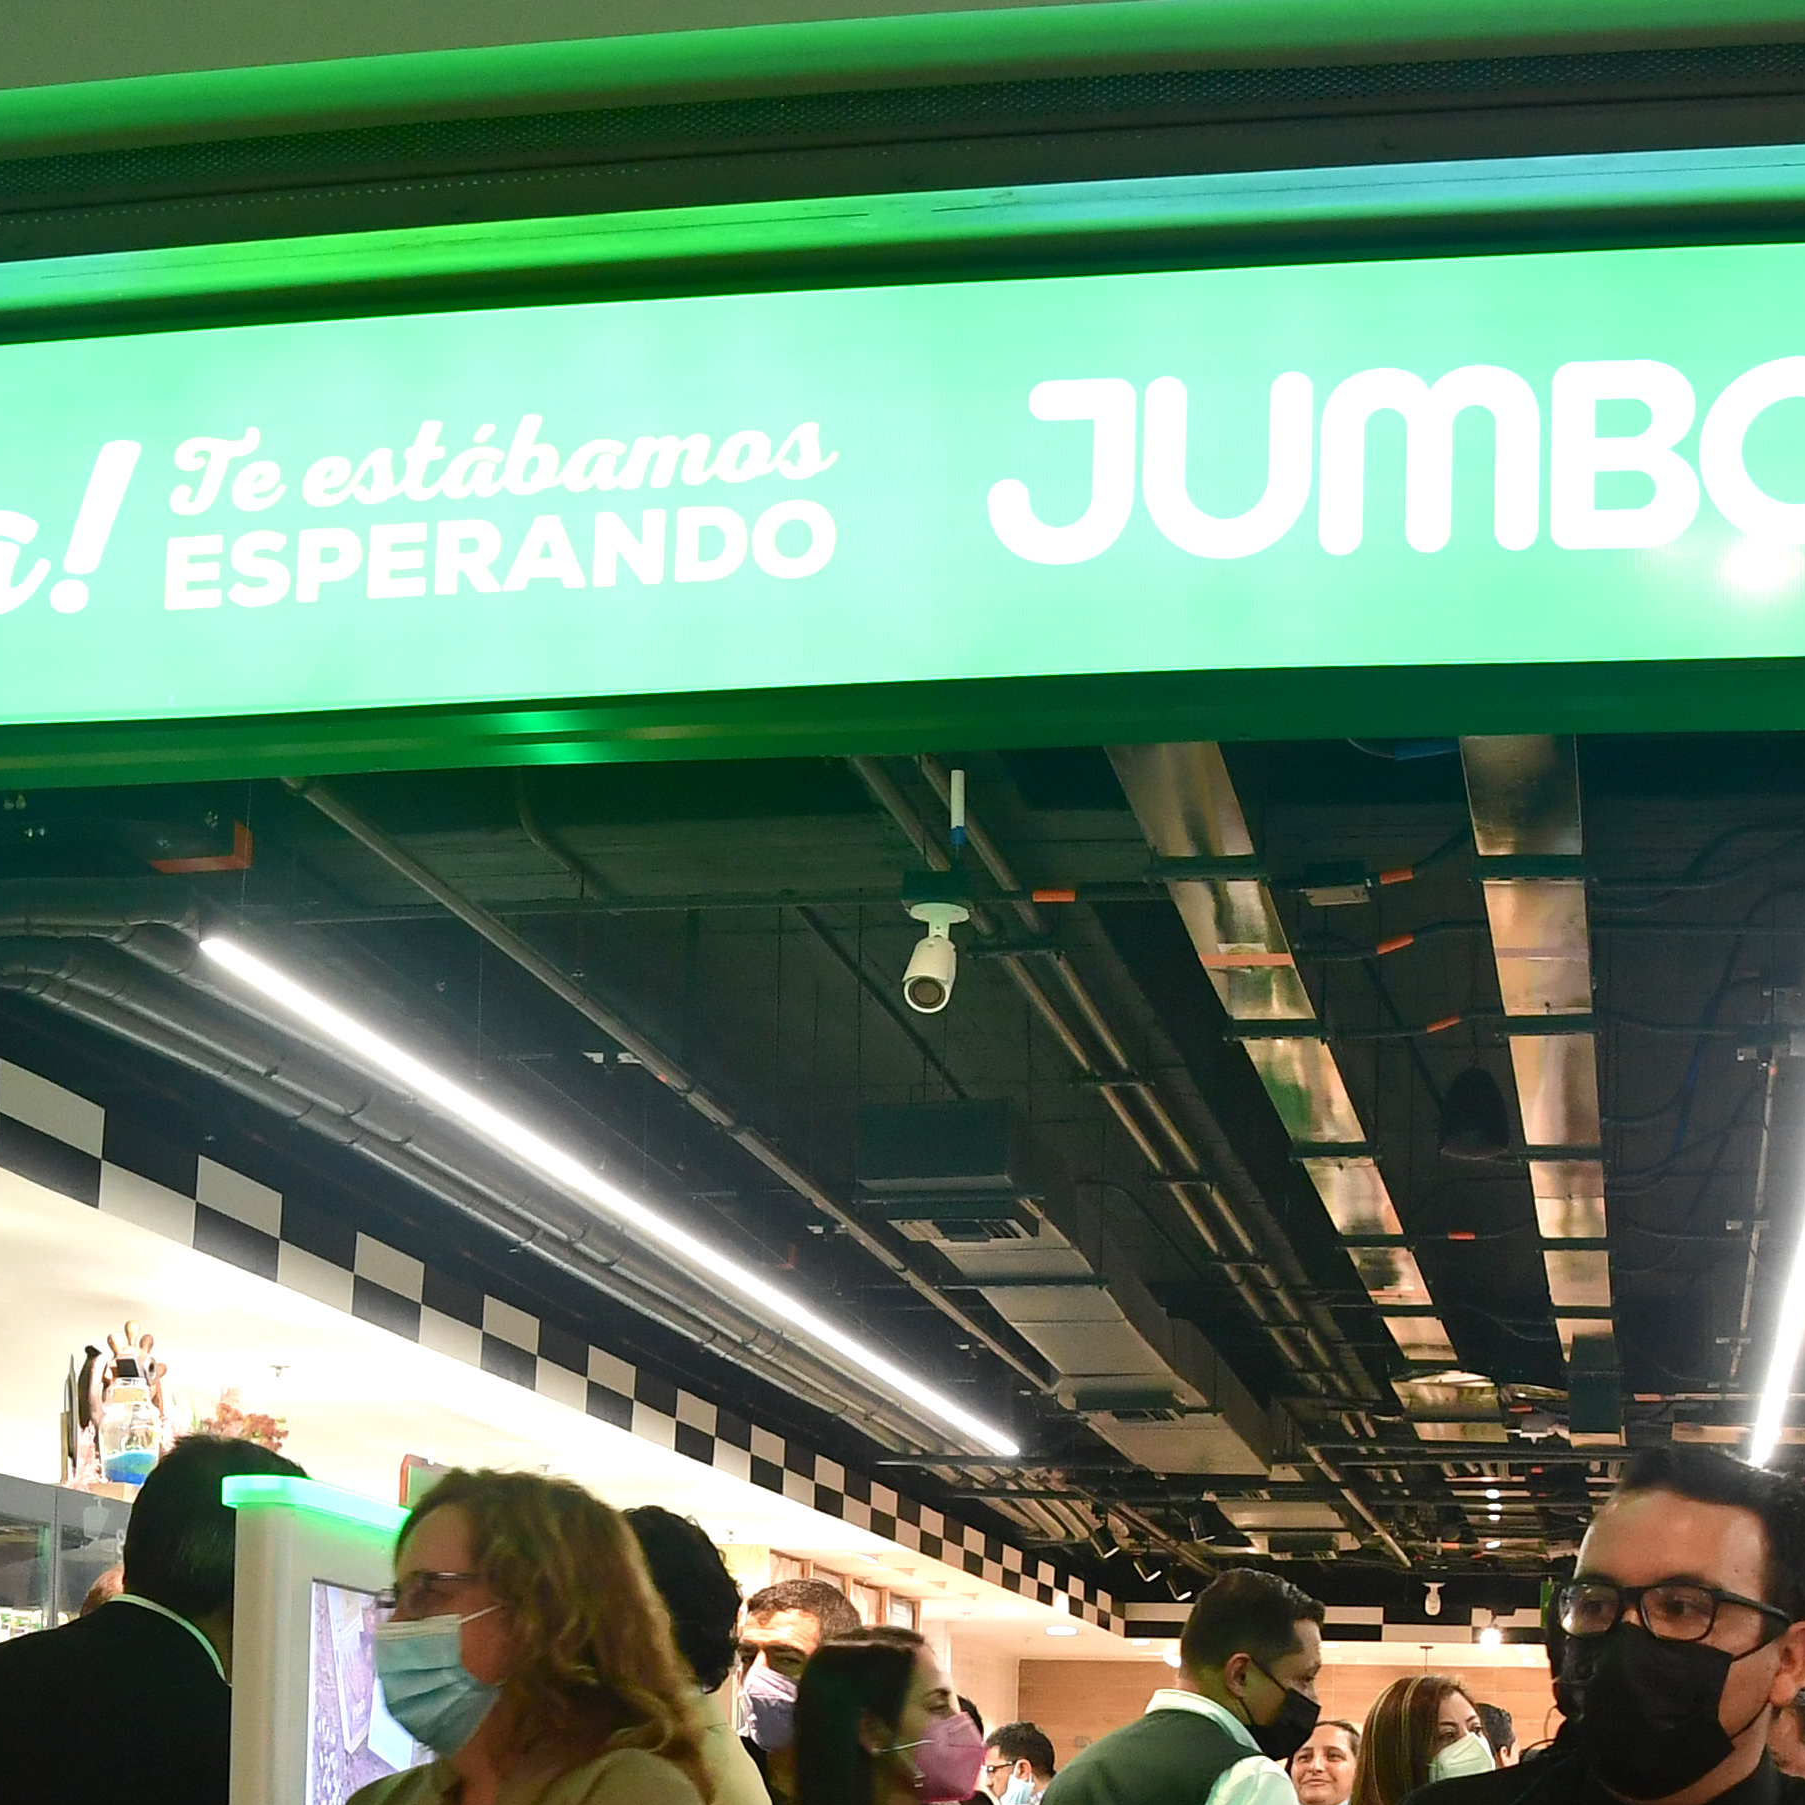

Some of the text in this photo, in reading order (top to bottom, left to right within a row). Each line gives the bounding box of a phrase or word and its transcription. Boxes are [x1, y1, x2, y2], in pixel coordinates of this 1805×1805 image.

[169, 413, 839, 516] Te estábamos
[163, 499, 837, 611] ESPERANDO
